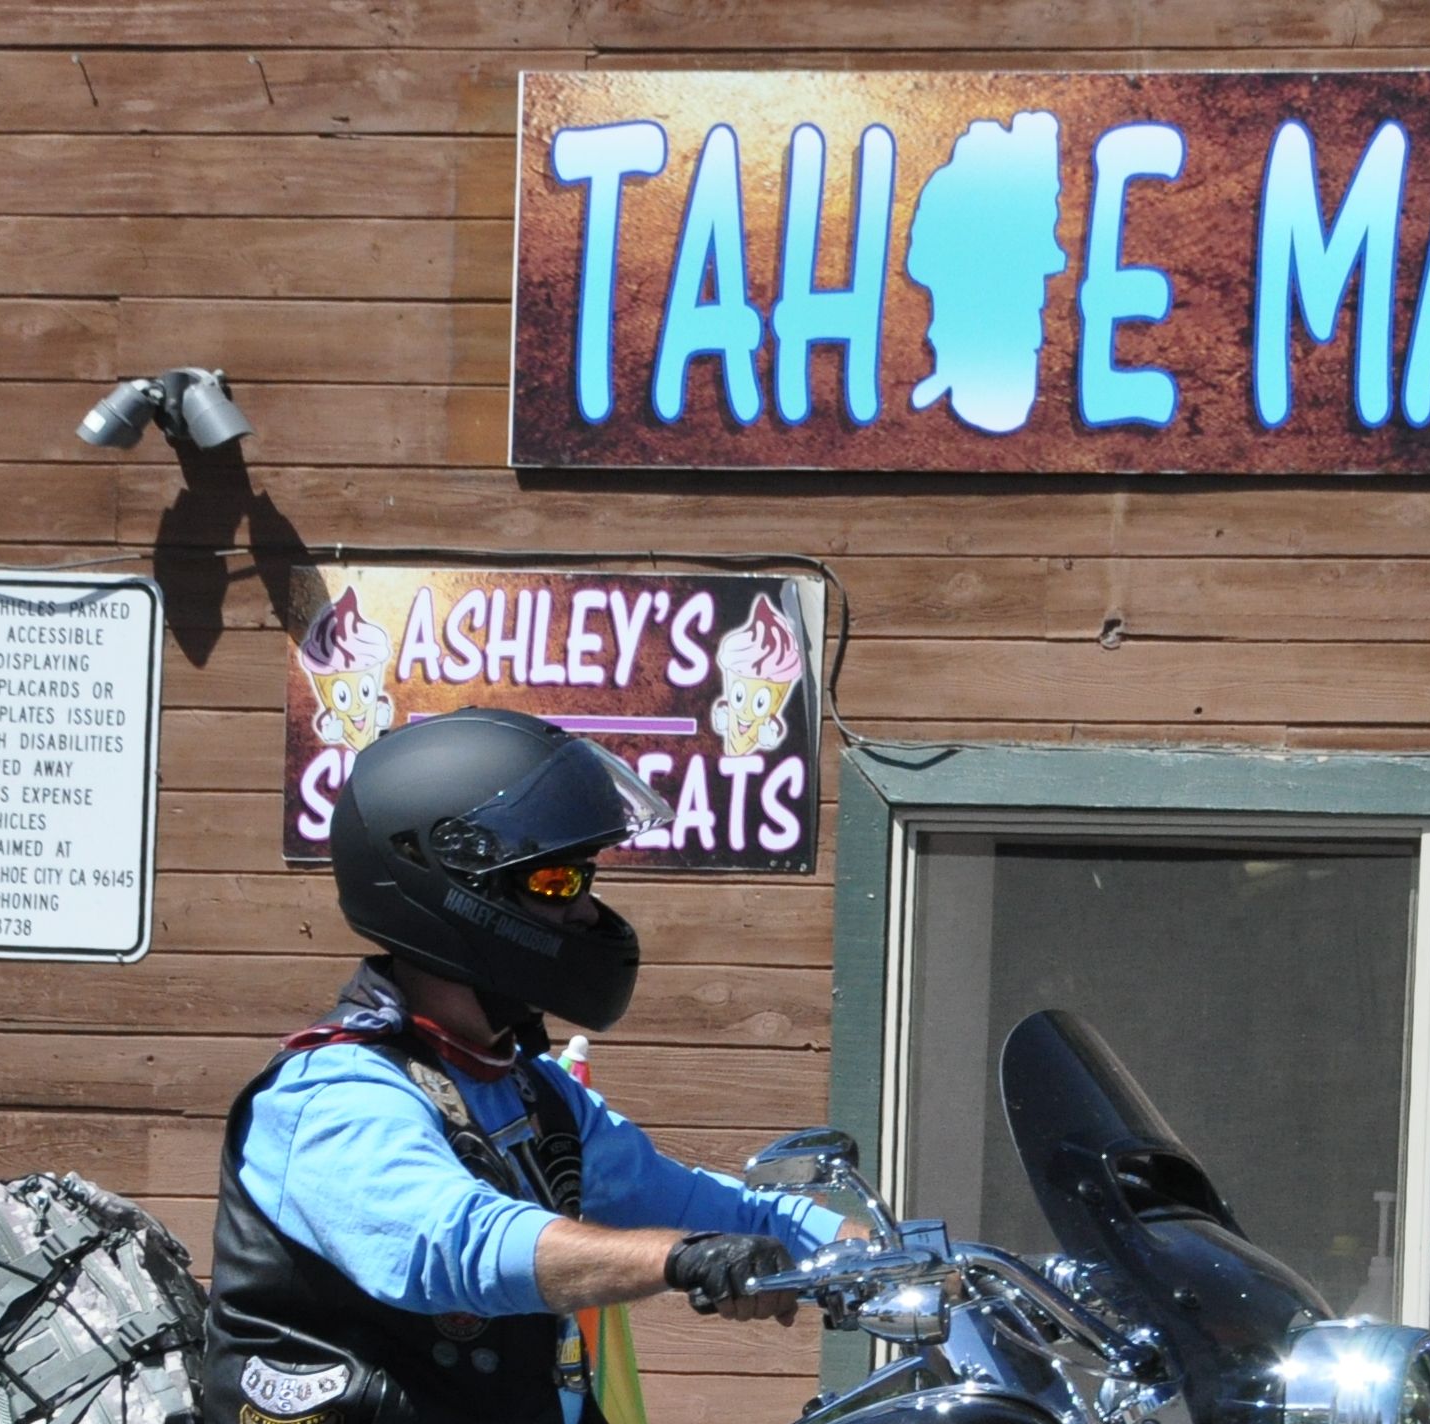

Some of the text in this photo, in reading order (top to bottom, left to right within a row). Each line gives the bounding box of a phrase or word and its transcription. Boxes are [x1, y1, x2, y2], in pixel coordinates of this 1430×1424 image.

[70, 601, 130, 619] PARKED
[7, 627, 103, 645] ACCESSIBLE
[395, 585, 716, 688] ASHLEY'S
[93, 682, 113, 699] OR
[0, 706, 55, 724] PLATES
[68, 708, 125, 726] ISSUED
[21, 733, 123, 752] DISABILITIES
[34, 760, 73, 778] AWAY
[22, 788, 93, 806] EXPENSE
[56, 841, 71, 858] AT
[34, 868, 62, 885] CITY
[69, 869, 86, 886] CA
[93, 870, 134, 888] 96145
[442, 887, 564, 959] HARLEY-DAVIDSON
